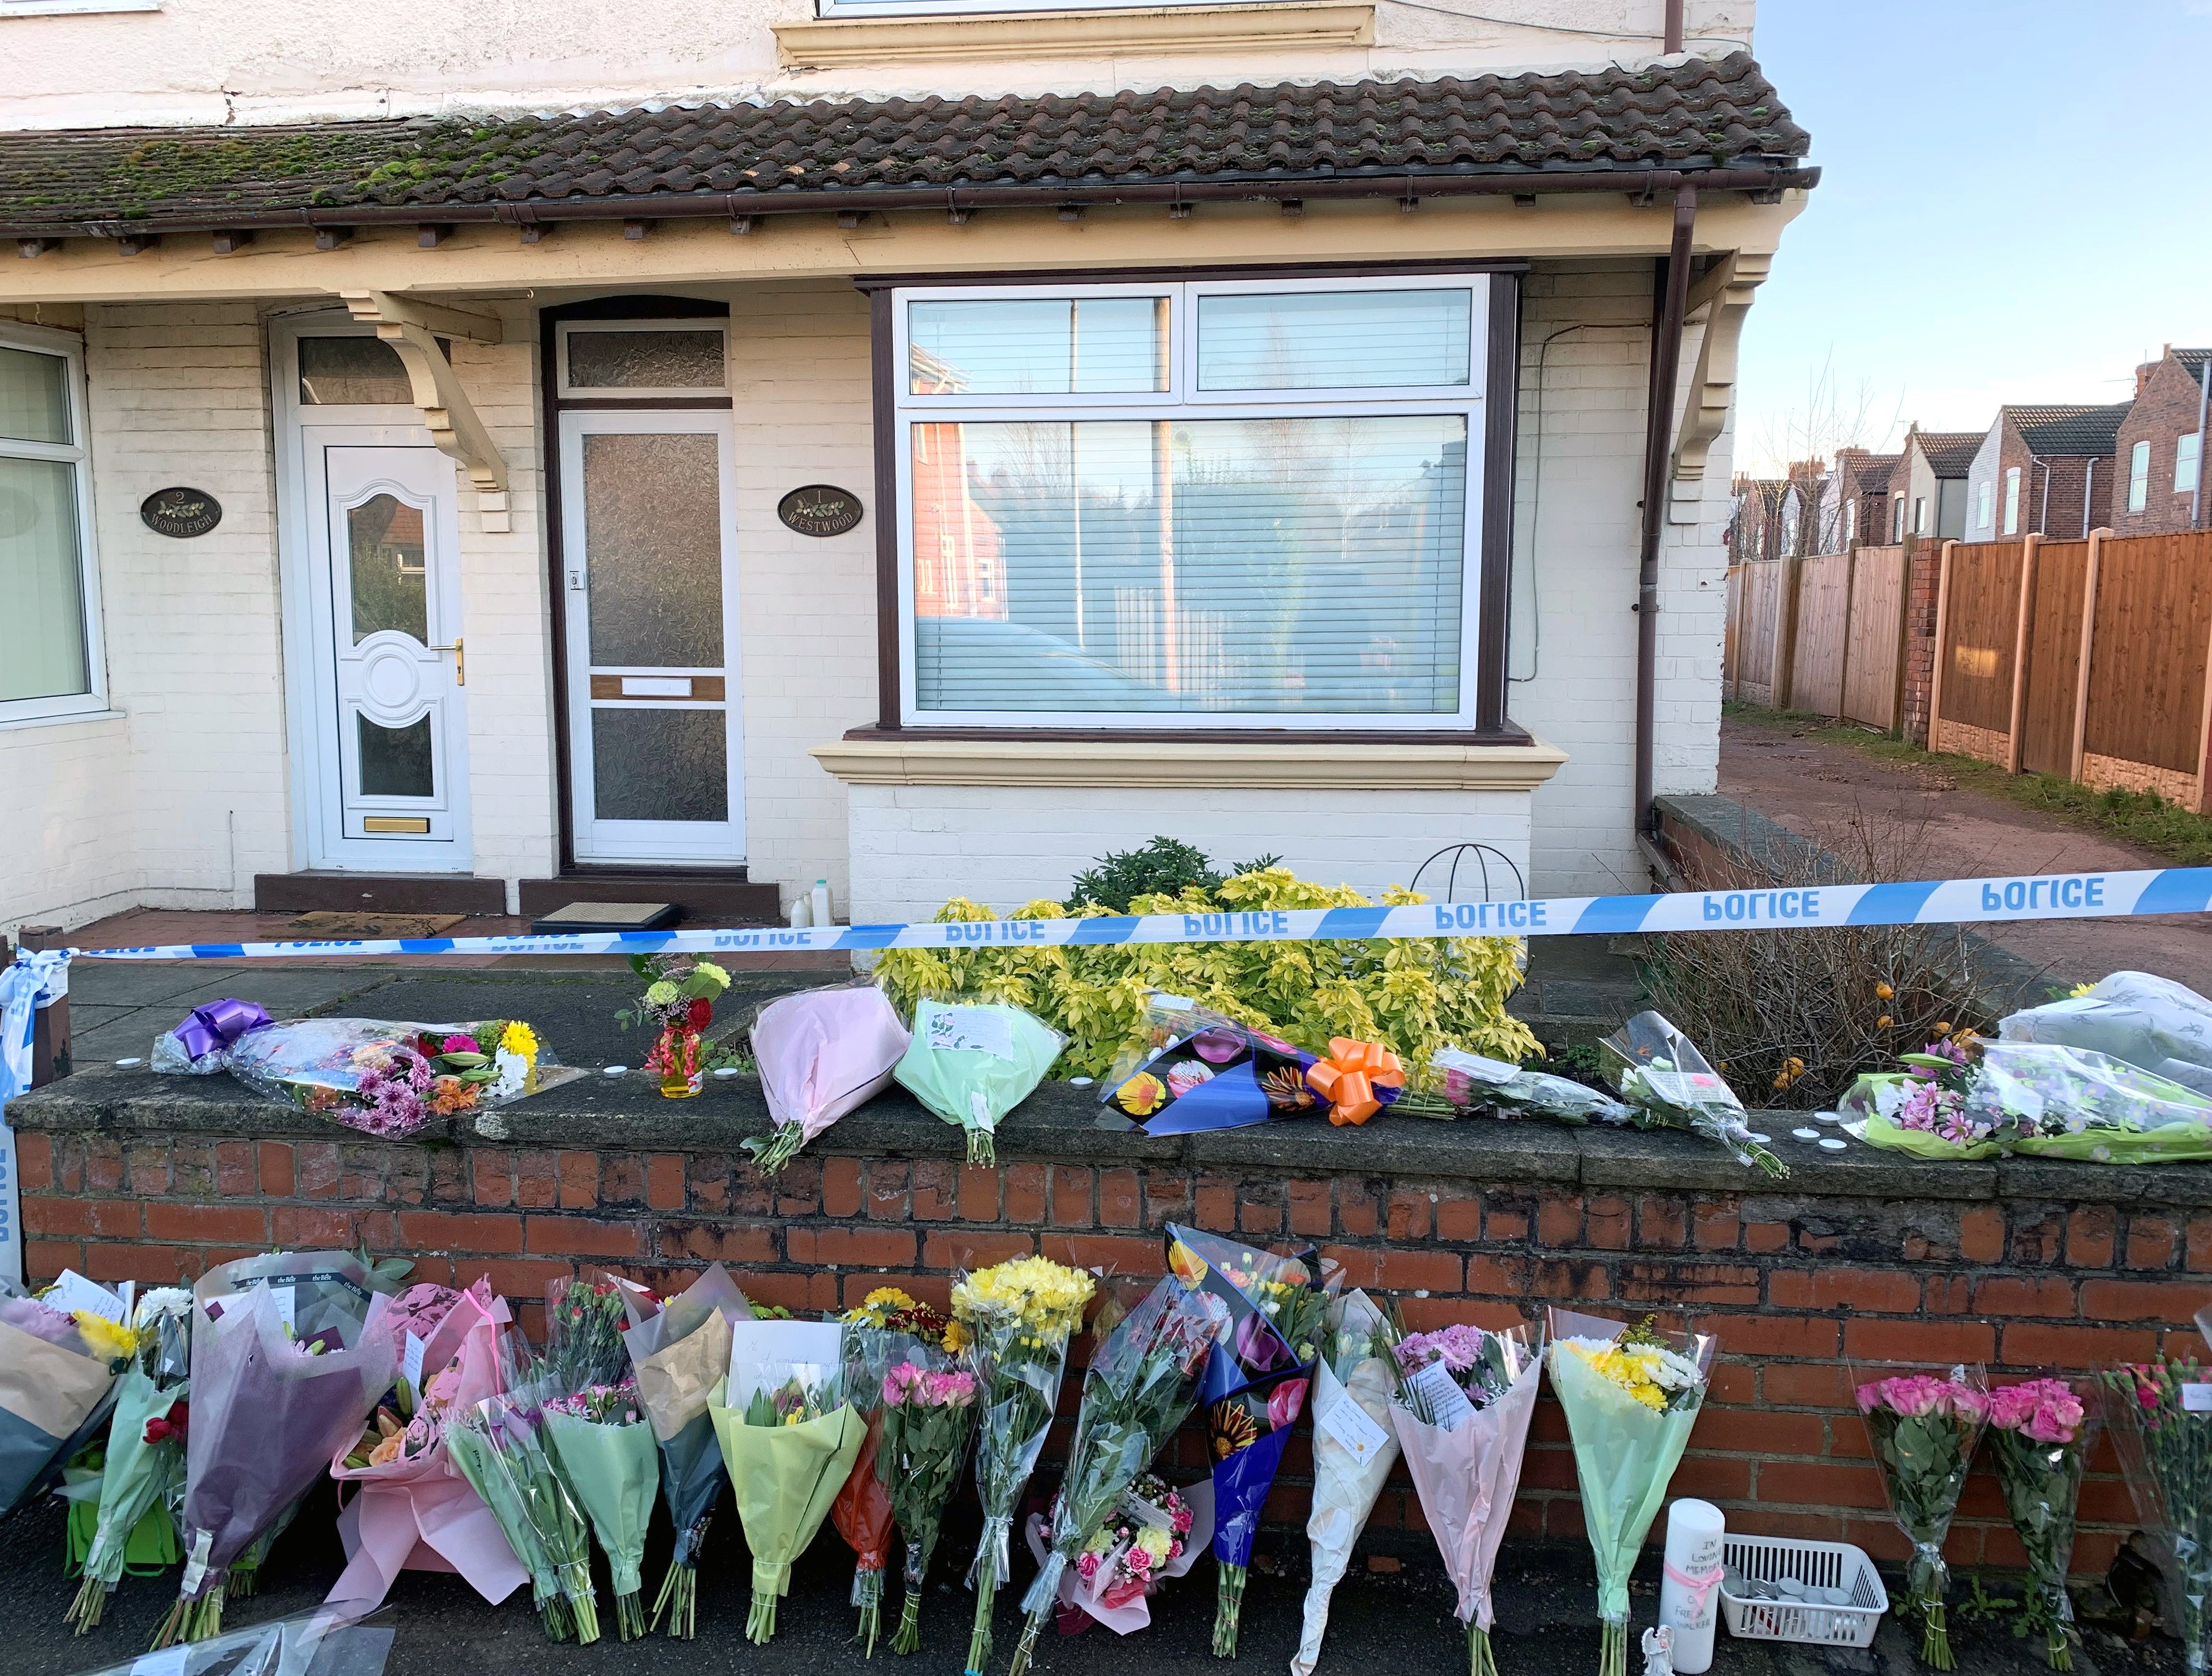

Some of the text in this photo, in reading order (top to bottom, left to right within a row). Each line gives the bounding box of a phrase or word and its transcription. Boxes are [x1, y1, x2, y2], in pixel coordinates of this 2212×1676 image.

[175, 491, 185, 504] 2
[817, 490, 821, 503] 1
[151, 513, 213, 533] WOODLEIGH
[788, 511, 853, 532] WESTWOOD
[344, 1281, 362, 1296] the Best
[1702, 1539, 1717, 1550] IN
[1675, 1605, 1706, 1619] FREA
[1677, 1618, 1711, 1630] WALKER
